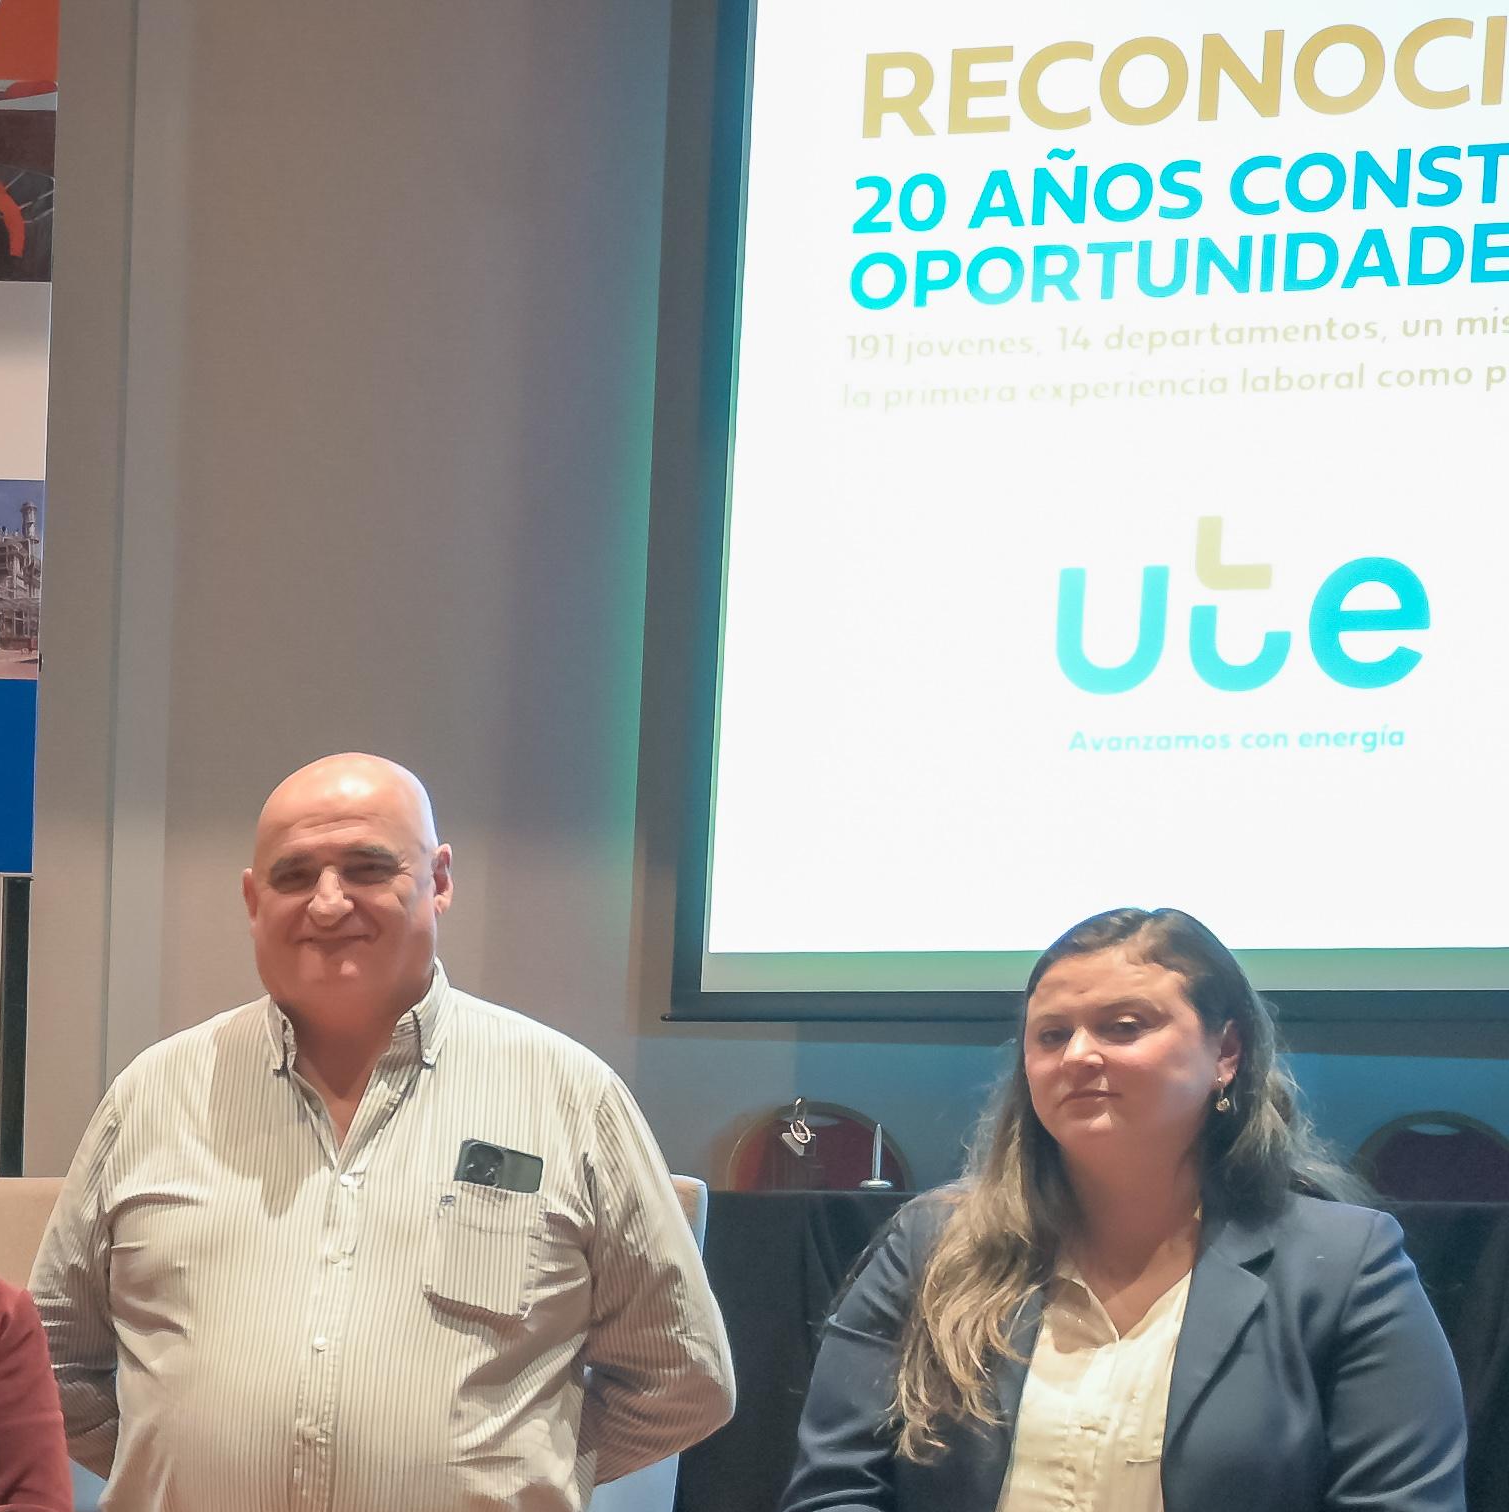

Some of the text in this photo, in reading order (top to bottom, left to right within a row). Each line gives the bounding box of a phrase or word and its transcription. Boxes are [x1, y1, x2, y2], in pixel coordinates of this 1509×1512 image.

[860, 15, 1508, 139] RECONOCI
[852, 142, 1509, 234] 20 AÑOS CONST
[849, 222, 1509, 310] OPORTUNIDADE
[1058, 325, 1092, 352] 14
[1104, 316, 1387, 356] departamentos,
[1402, 317, 1443, 338] un
[844, 382, 872, 409] la
[884, 380, 1017, 413] primera
[1029, 369, 1229, 408] experiencia
[1241, 362, 1365, 394] laboral
[1377, 366, 1473, 388] como
[1055, 515, 1432, 695] ute
[1068, 724, 1406, 753] Avanzamos con energía
